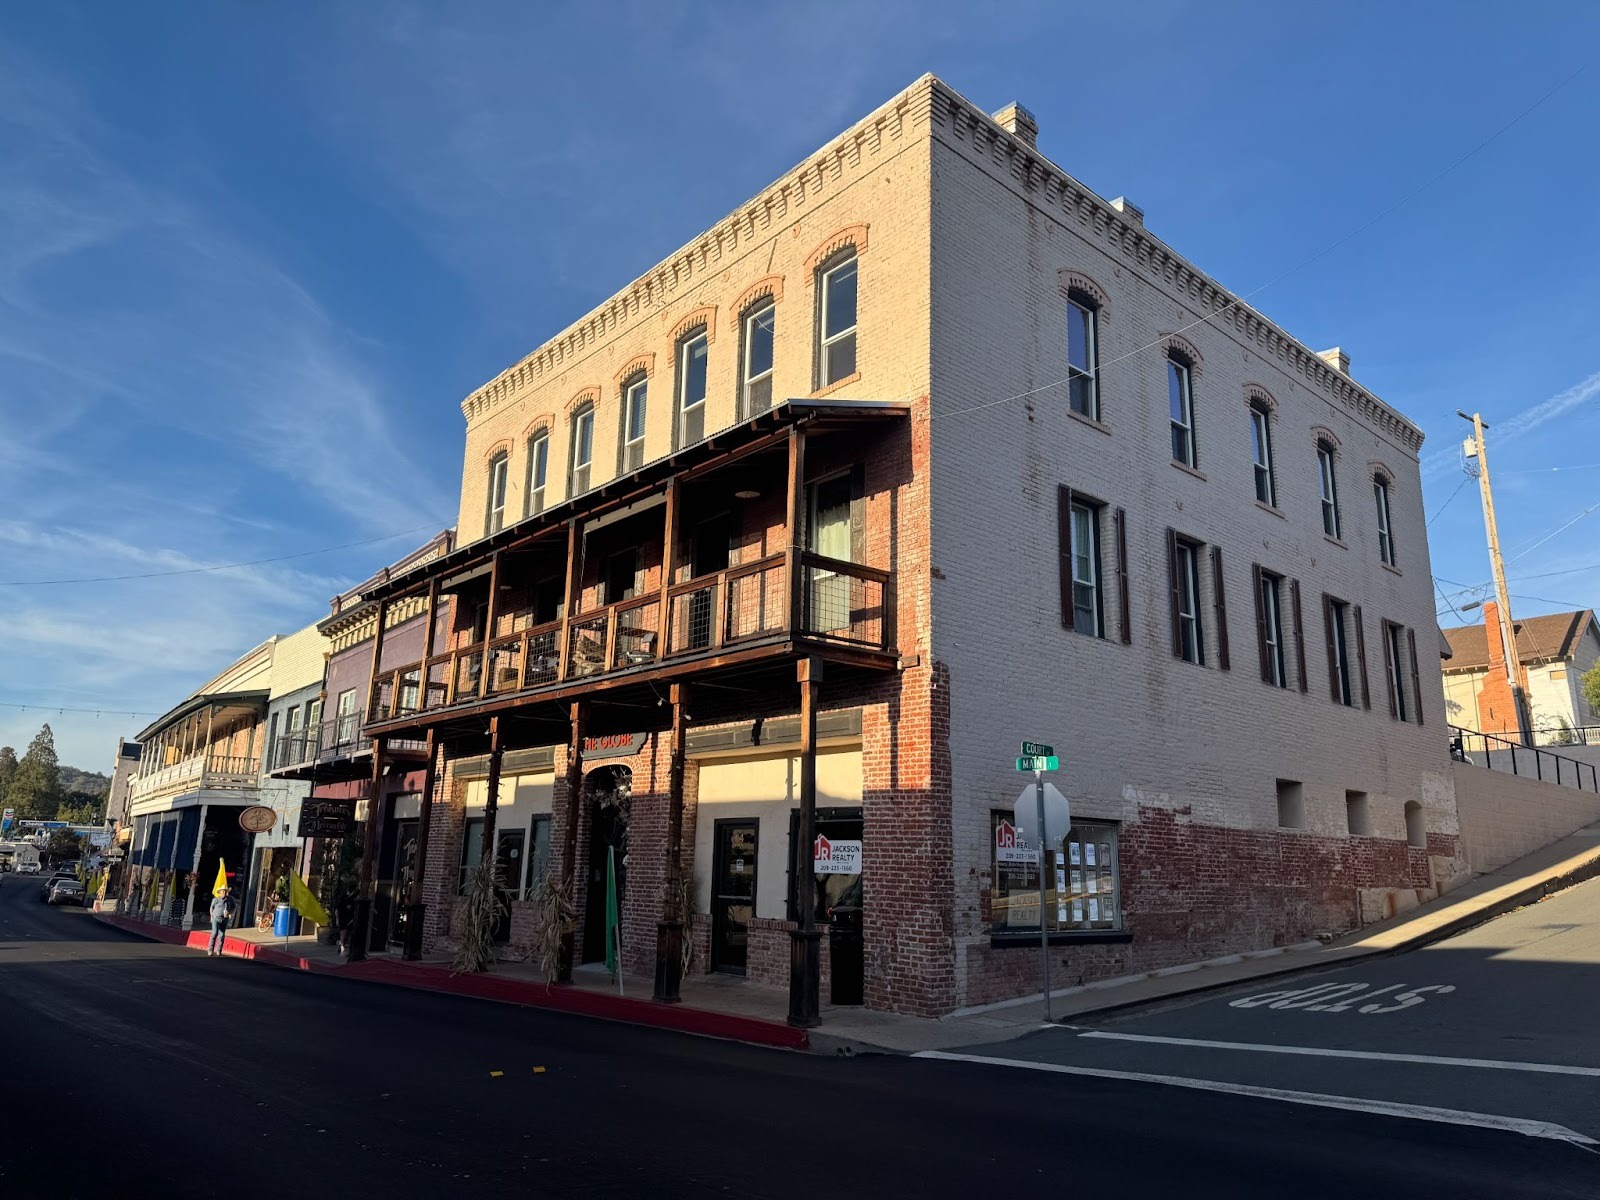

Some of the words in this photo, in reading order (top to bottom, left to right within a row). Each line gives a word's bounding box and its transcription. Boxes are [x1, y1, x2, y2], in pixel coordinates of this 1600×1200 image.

[600, 733, 633, 750] GLOBE
[1026, 743, 1046, 756] COURT
[1022, 758, 1043, 769] MAIN
[832, 845, 860, 853] JACKSON
[1229, 982, 1456, 1014] STOP
